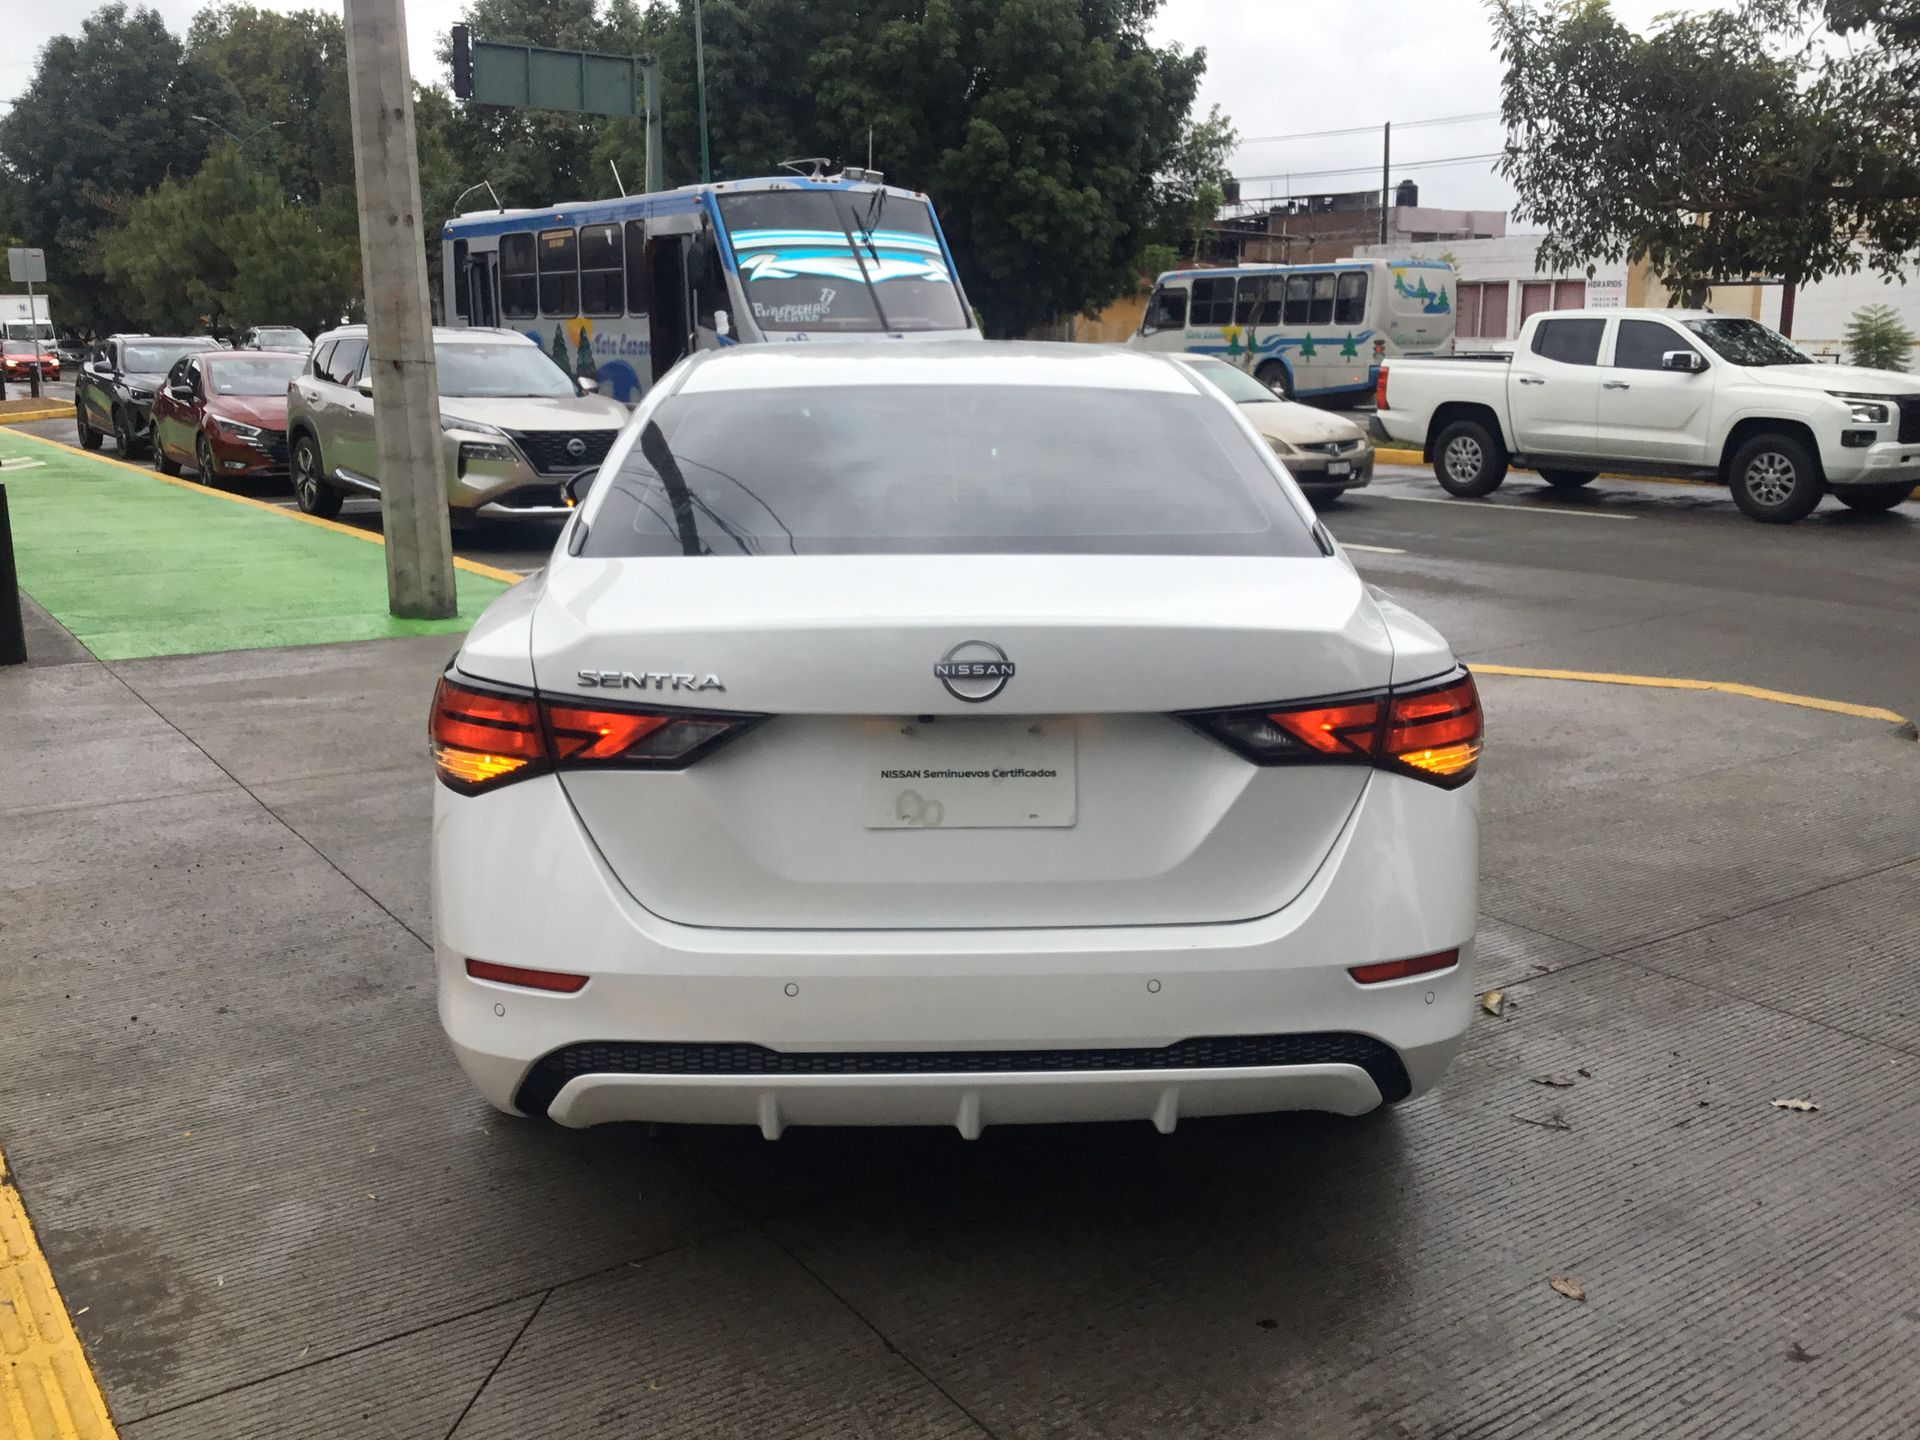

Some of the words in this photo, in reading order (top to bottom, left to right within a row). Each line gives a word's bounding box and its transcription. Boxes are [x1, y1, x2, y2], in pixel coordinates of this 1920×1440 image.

[935, 664, 1015, 676] NISSAN
[577, 669, 726, 692] SENTRA
[880, 769, 921, 779] NISSAN
[923, 769, 990, 779] Seminuevos
[992, 768, 1057, 779] Certificados
